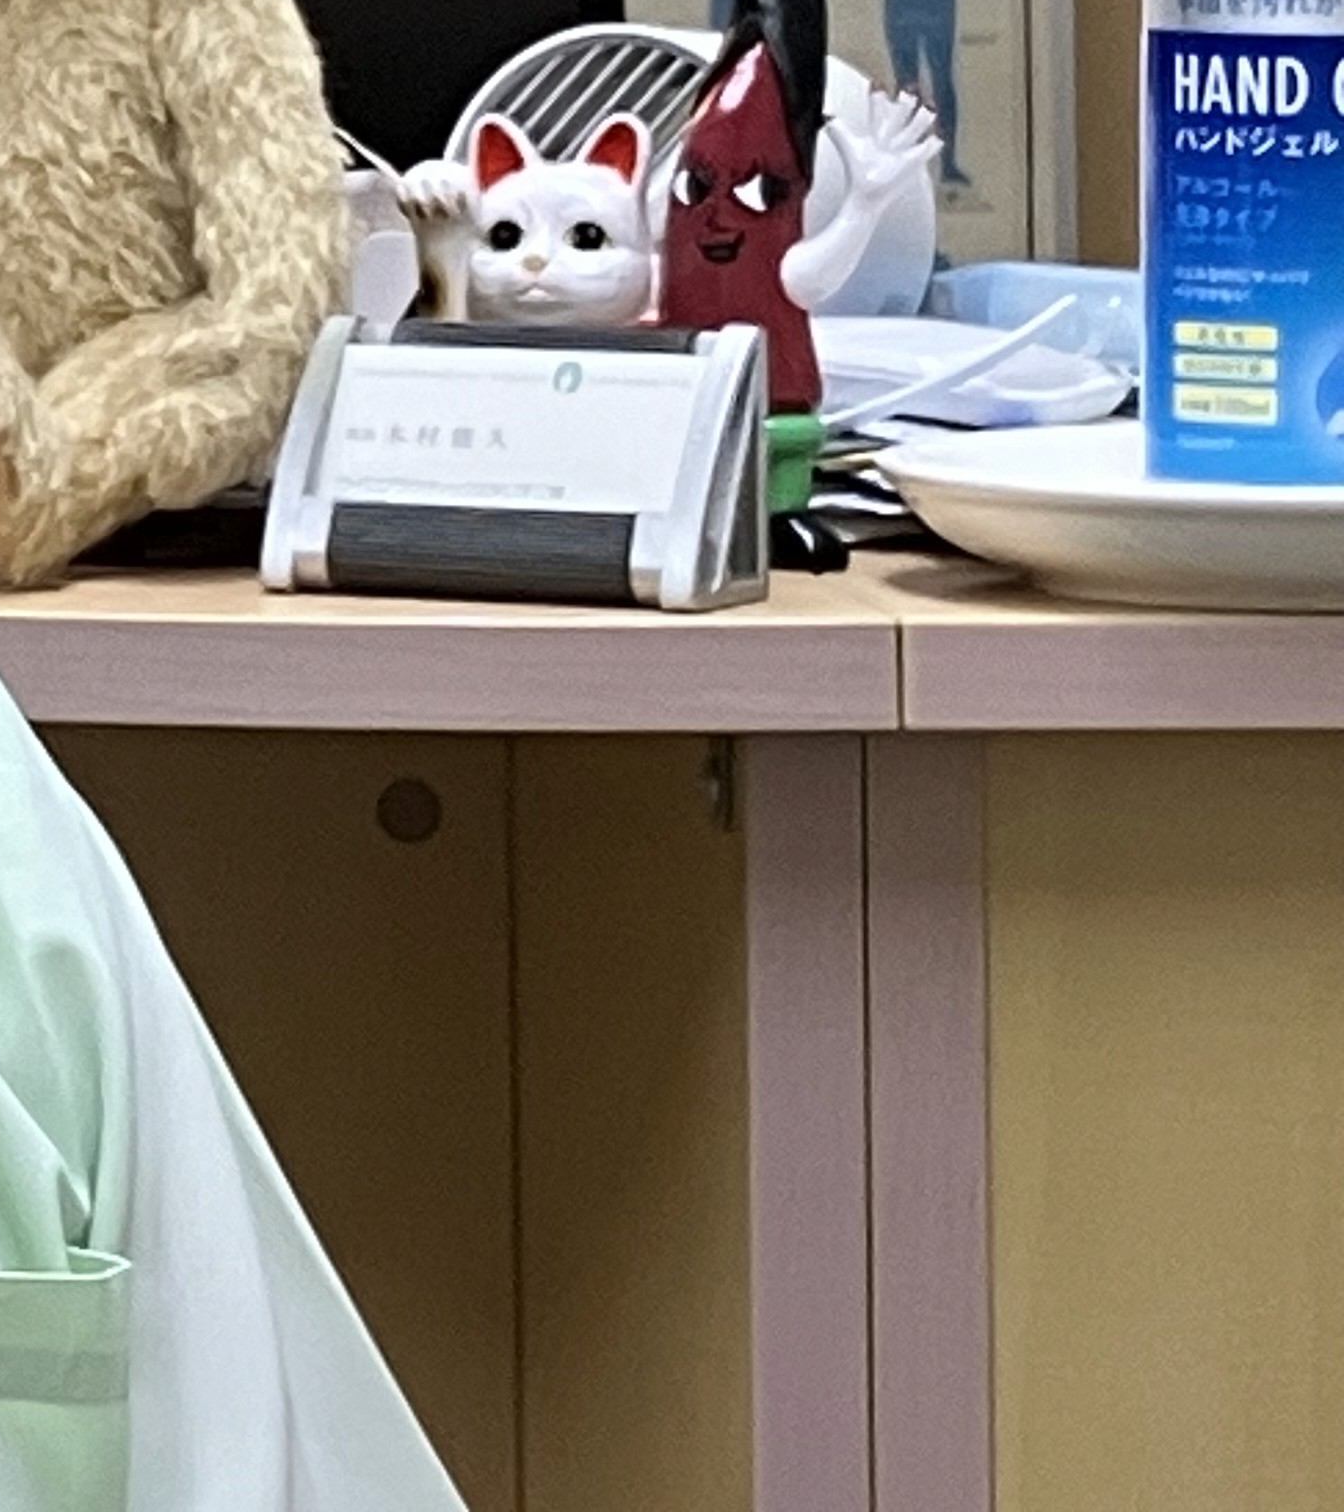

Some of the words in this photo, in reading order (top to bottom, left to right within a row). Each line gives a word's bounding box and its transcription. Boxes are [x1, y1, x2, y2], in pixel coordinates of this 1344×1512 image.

[1174, 51, 1310, 117] HAND
[1174, 124, 1340, 158] ハンドジェル
